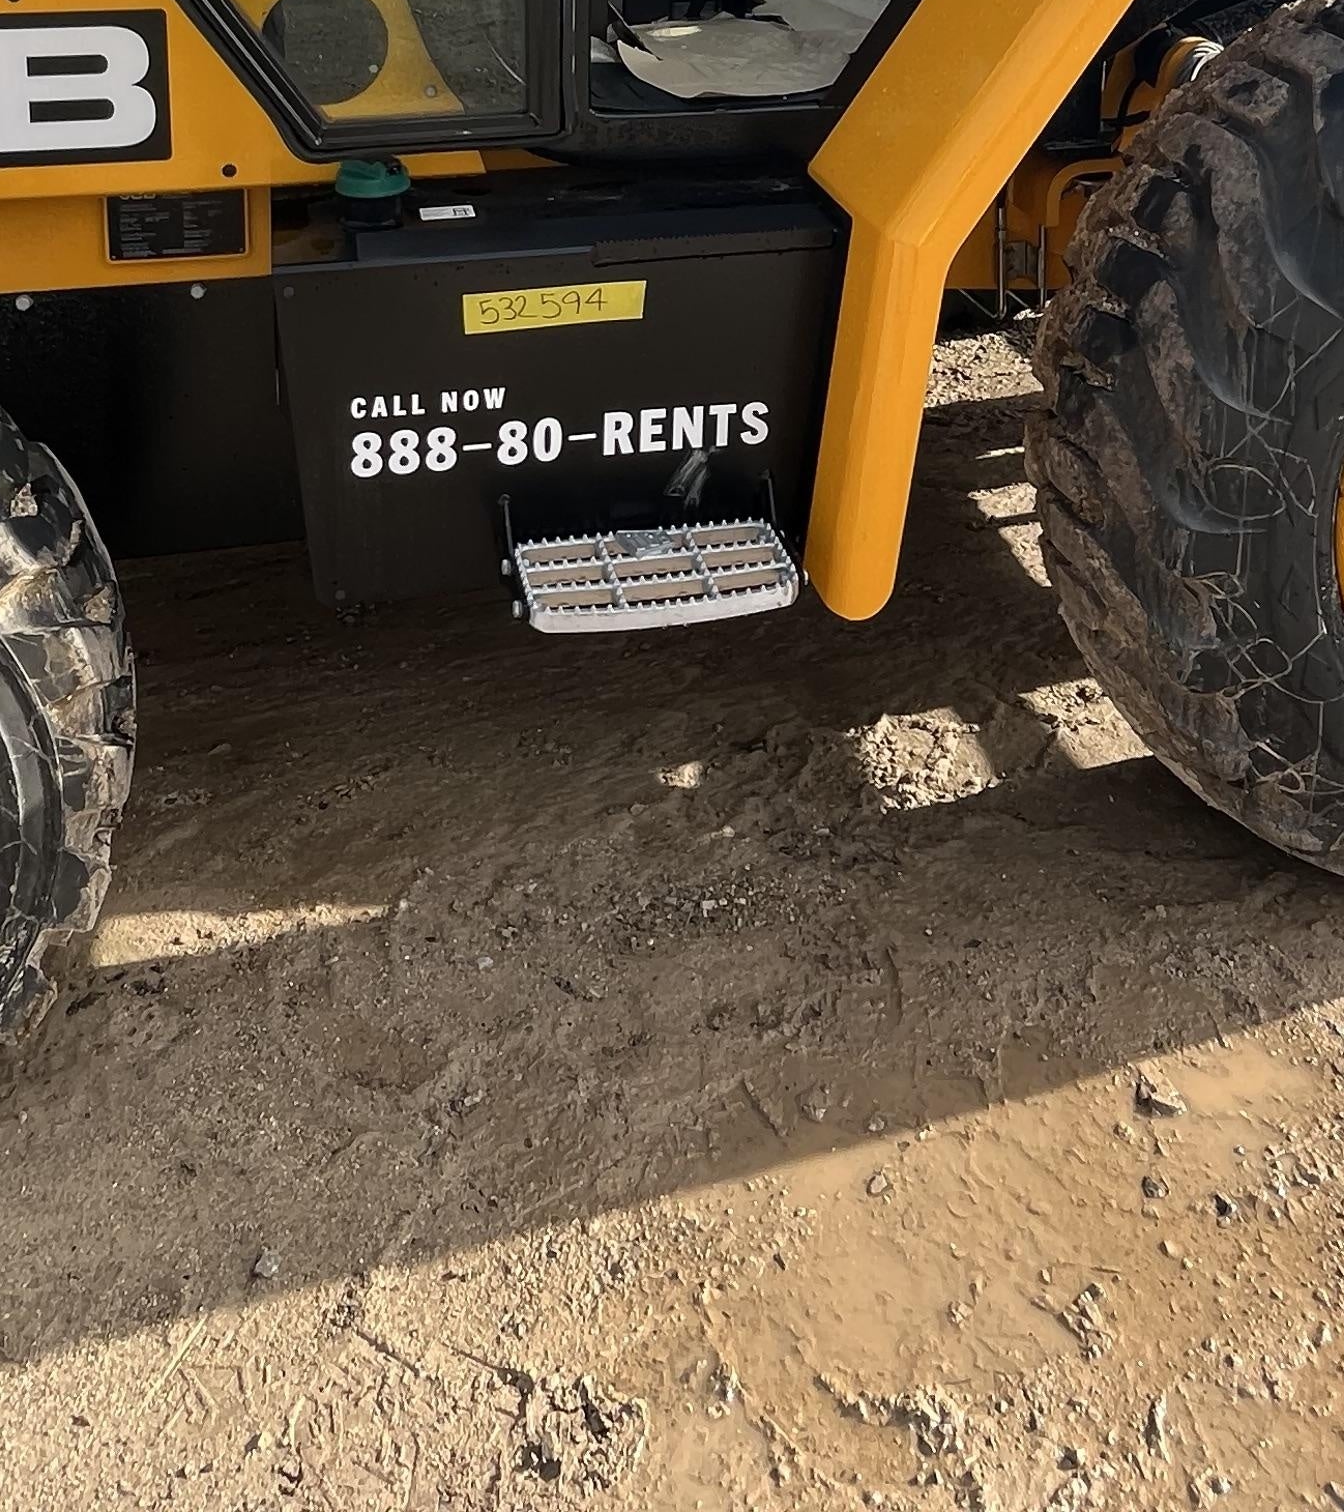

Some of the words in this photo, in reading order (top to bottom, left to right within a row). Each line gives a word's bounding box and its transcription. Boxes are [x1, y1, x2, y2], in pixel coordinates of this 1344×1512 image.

[349, 394, 426, 420] CALL
[441, 386, 507, 414] NOW
[349, 401, 770, 479] 888-80-RENTS
